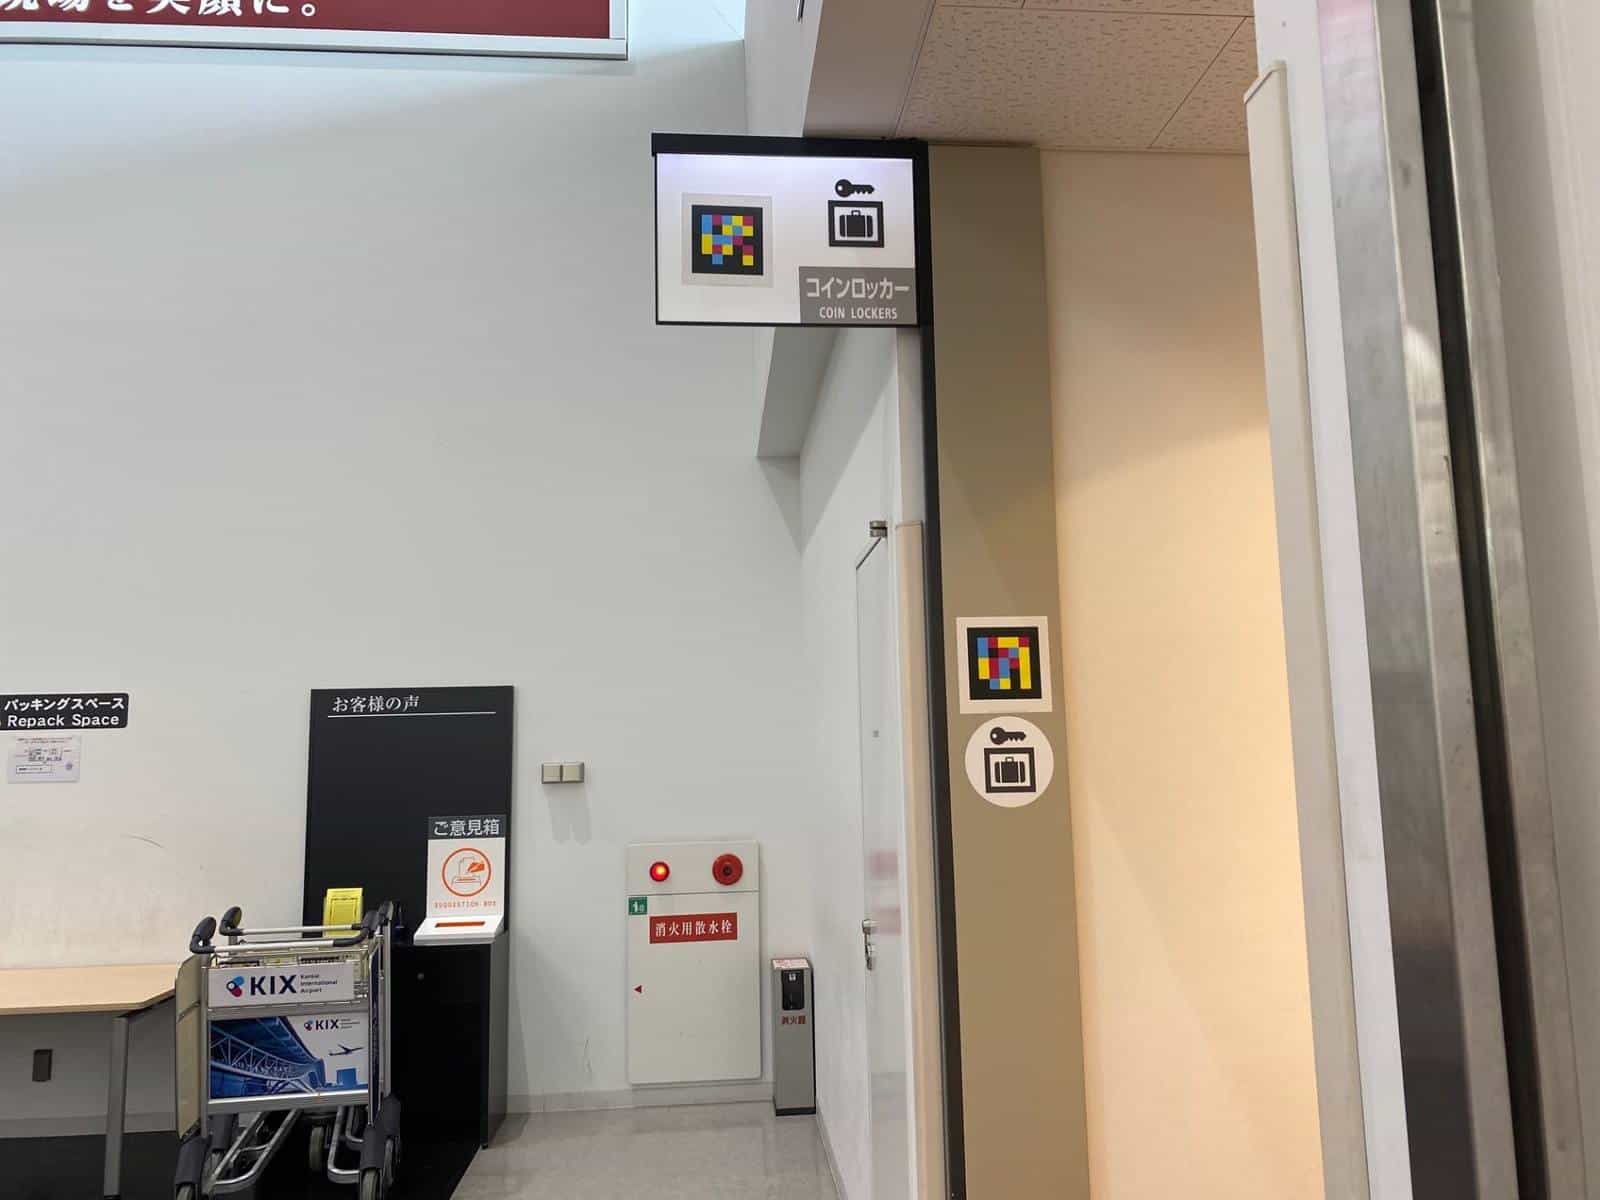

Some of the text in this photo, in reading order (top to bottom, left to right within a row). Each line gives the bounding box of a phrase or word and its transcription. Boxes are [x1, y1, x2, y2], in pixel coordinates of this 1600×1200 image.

[805, 276, 910, 299] コインロッカー
[819, 306, 898, 320] COIN LOCKERS
[332, 694, 420, 713] お客様の声
[7, 714, 65, 728] Repack
[71, 713, 120, 727] Space
[433, 819, 500, 836] ご意見箱
[655, 919, 733, 937] 消火用散水栓
[250, 974, 297, 996] KIX
[315, 1019, 339, 1031] KIX
